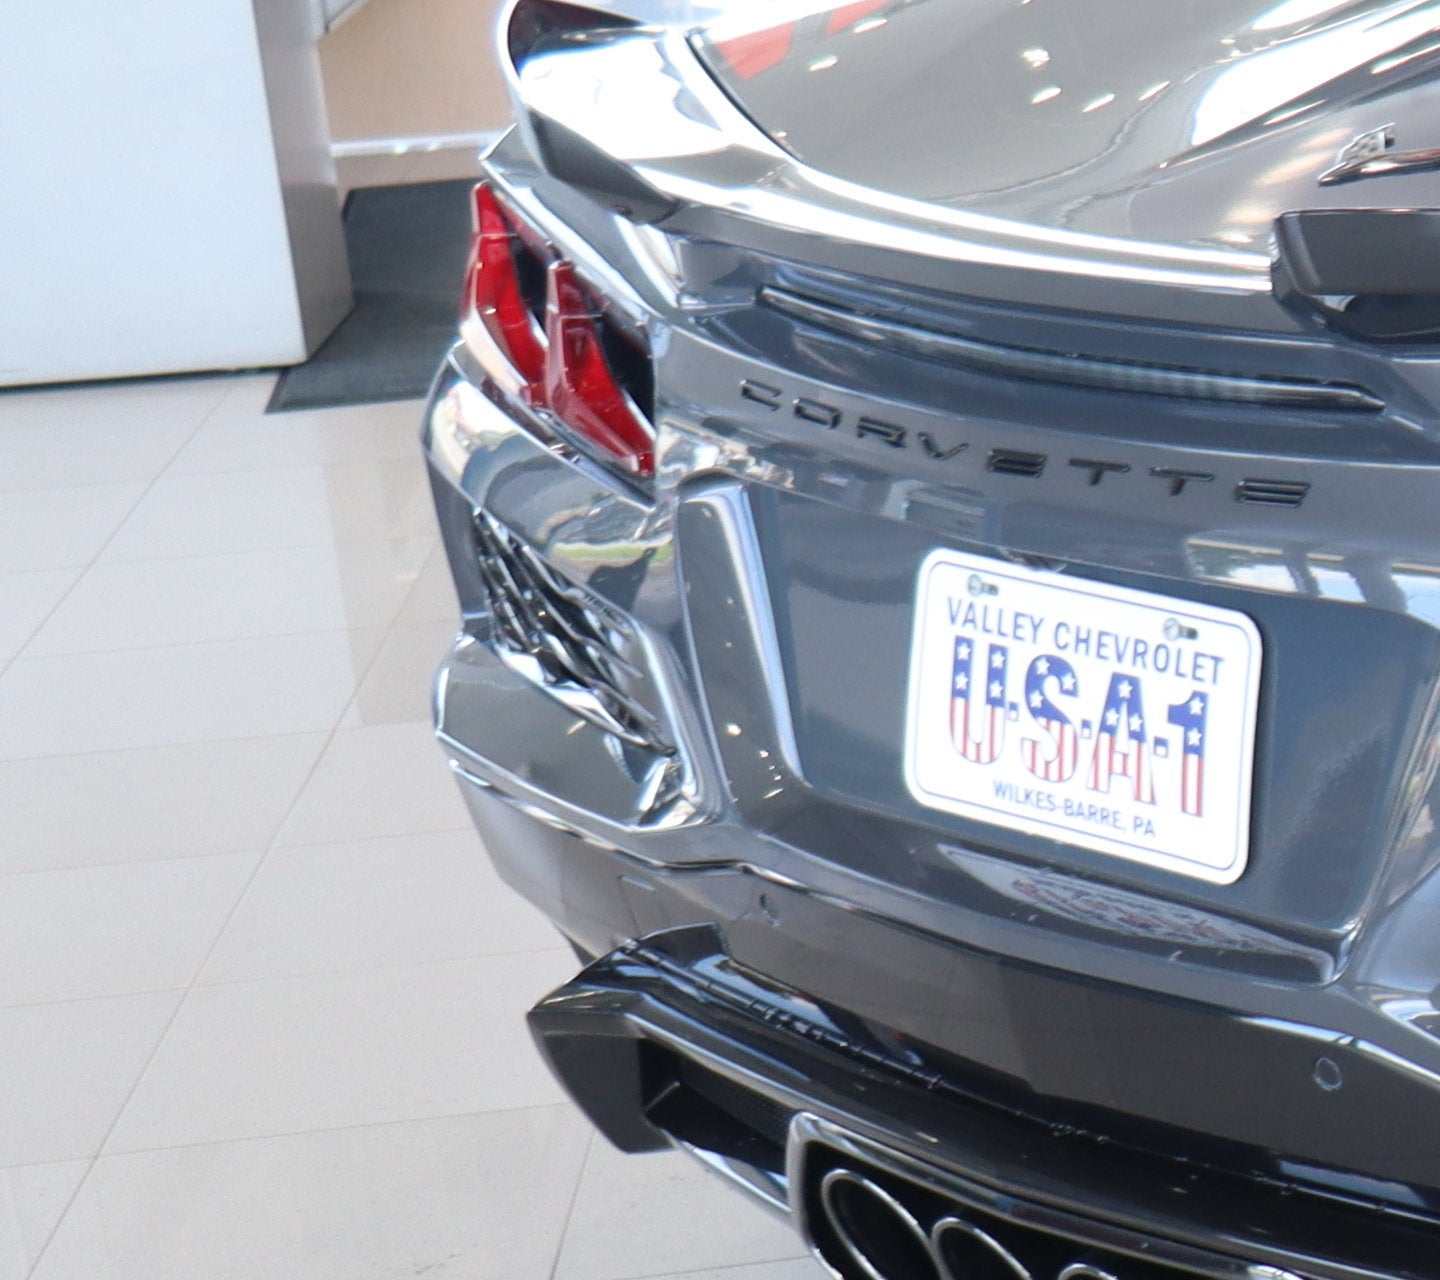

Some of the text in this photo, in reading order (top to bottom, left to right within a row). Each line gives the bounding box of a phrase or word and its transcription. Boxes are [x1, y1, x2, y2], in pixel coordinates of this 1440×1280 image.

[739, 377, 1312, 508] CORVETTE
[947, 595, 1226, 686] VALLEY CHEVROLET
[1132, 816, 1157, 838] PA
